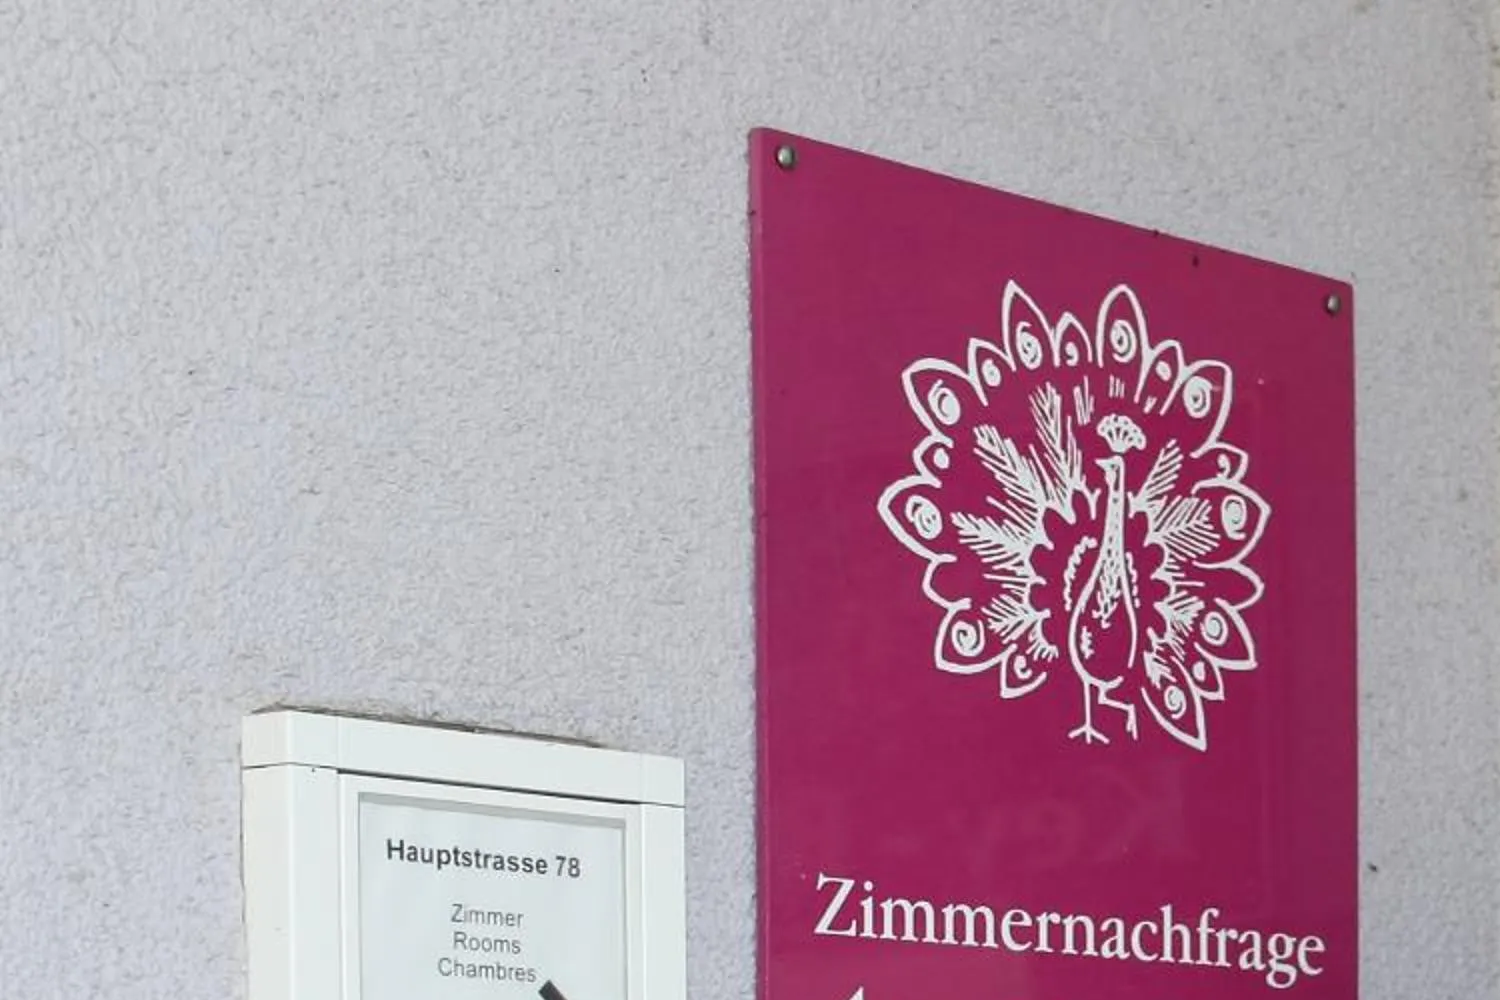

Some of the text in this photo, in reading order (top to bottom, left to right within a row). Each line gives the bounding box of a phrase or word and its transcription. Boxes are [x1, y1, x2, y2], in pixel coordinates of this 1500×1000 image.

[387, 838, 581, 879] Hauptstrasse 78
[450, 903, 525, 928] Zimmer
[453, 931, 522, 955] Rooms
[814, 872, 1326, 988] Zimmernachfrage
[437, 957, 537, 983] Chambres
